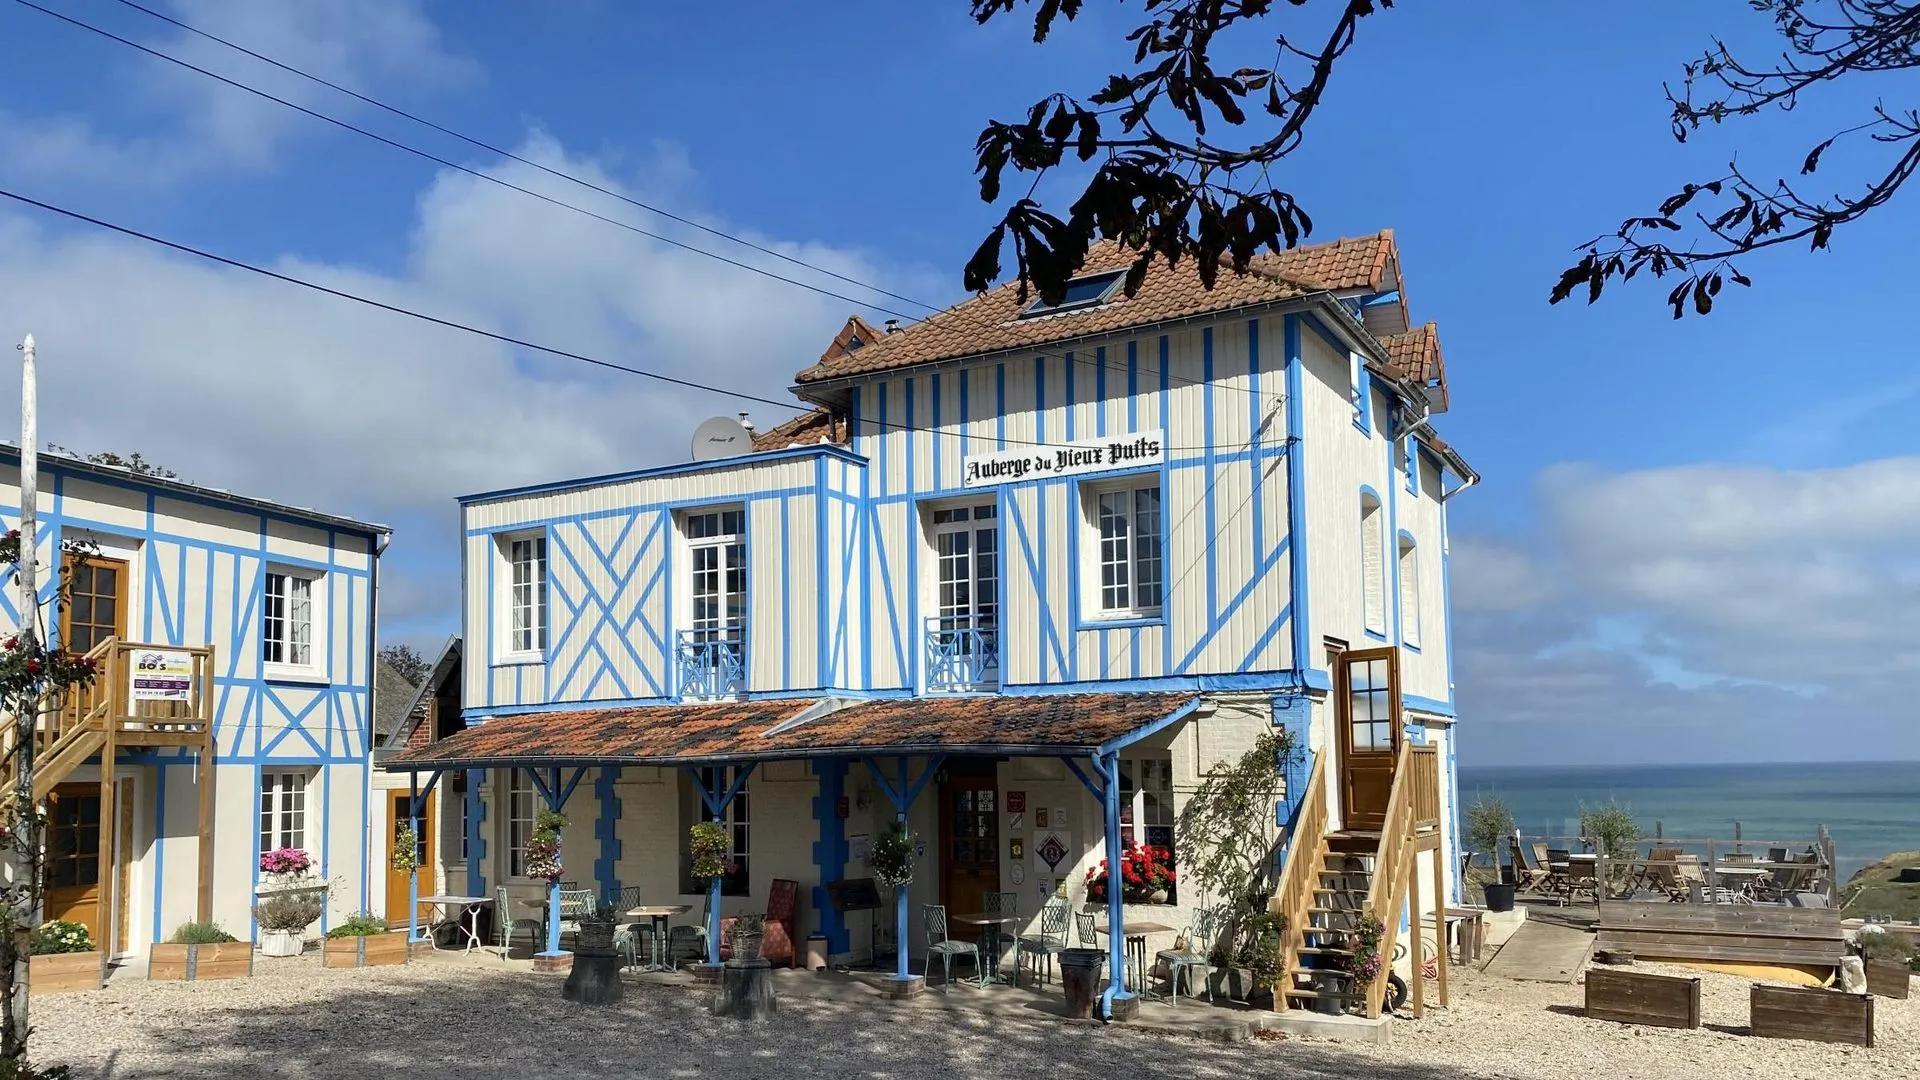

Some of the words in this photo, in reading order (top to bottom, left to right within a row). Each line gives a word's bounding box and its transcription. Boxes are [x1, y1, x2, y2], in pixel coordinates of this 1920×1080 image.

[965, 458, 1031, 484] Auberge
[1035, 456, 1052, 471] du
[1054, 447, 1103, 472] Vieux
[1108, 437, 1159, 464] Puits
